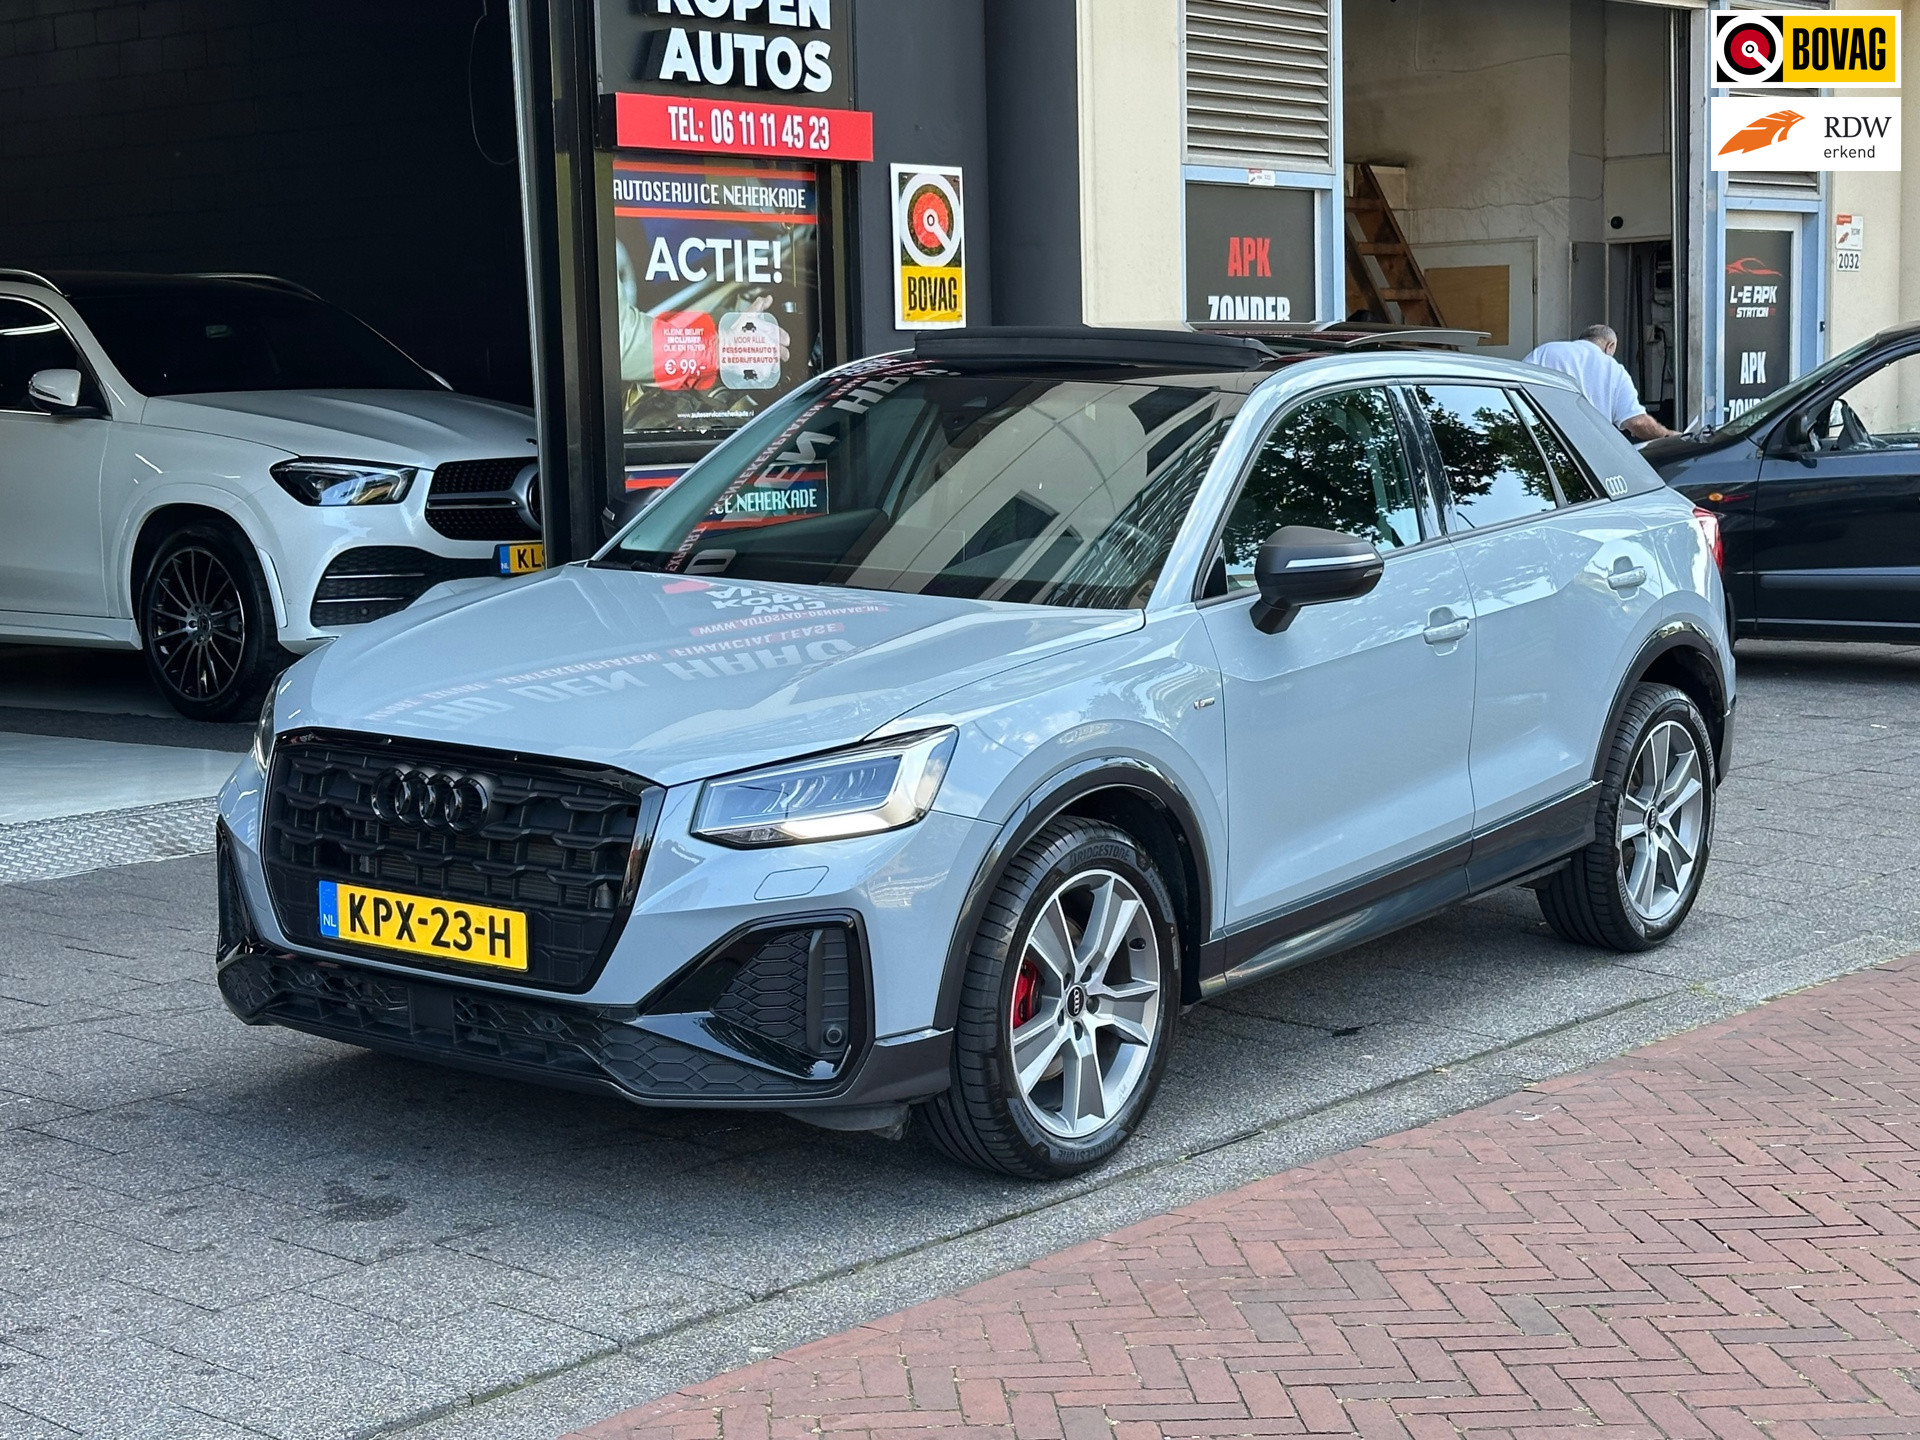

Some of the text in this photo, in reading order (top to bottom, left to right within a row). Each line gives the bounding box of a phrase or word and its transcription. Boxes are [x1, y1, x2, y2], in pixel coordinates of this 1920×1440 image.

[659, 27, 833, 93] AUTOS
[668, 106, 830, 150] TEL: 06 11 11 45 23
[613, 179, 806, 209] AUTOSERVICE NEHERKADE
[645, 237, 783, 284] ACTIE!
[1228, 237, 1272, 277] APK
[1838, 253, 1860, 269] 2032
[908, 276, 957, 312] BOVAG
[1208, 295, 1290, 321] ZONDER
[1754, 286, 1777, 304] APK
[1736, 307, 1769, 318] STATION
[680, 359, 706, 376] 99,-
[1740, 351, 1767, 384] APK
[736, 489, 817, 513] NEHERKADE
[517, 548, 544, 569] KL
[323, 914, 336, 928] NL
[349, 892, 511, 959] KPX-23-H
